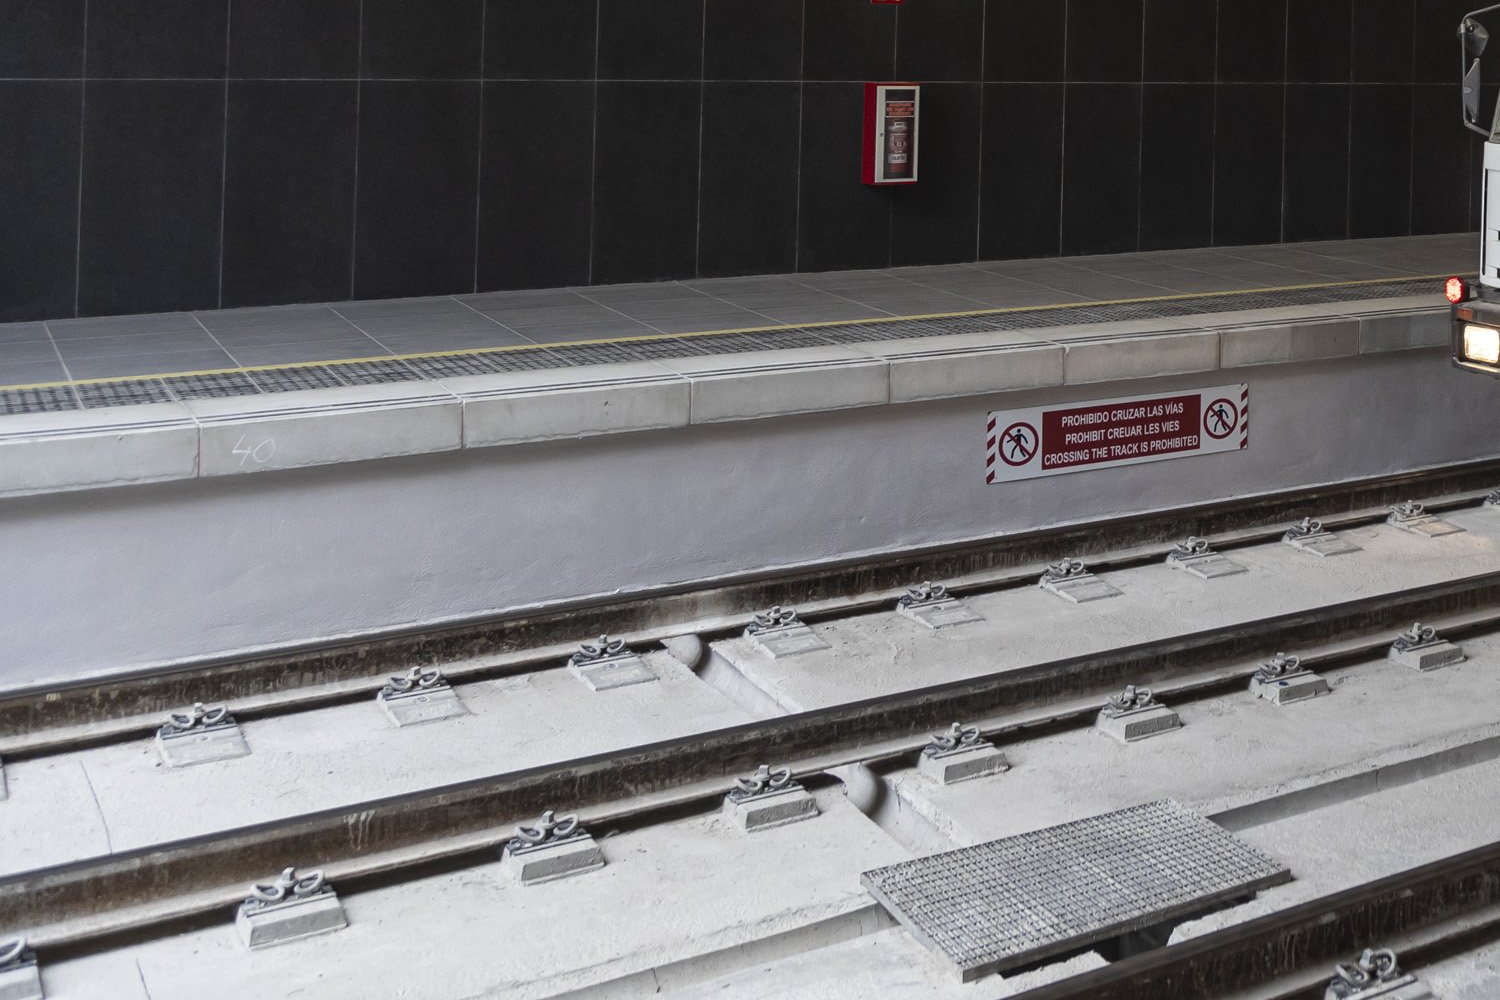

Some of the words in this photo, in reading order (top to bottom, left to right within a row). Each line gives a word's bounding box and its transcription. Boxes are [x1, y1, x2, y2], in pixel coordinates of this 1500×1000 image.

[1061, 411, 1109, 428] PROHIBIDO
[1110, 408, 1146, 423] CRUZAR
[1147, 405, 1164, 418] LAS
[1165, 401, 1184, 416] VÍAS
[1065, 429, 1106, 445] PROHIBIT
[1107, 425, 1143, 440] CREUAR
[1144, 422, 1160, 436] LES
[1161, 419, 1180, 433] VIES
[232, 434, 276, 465] 40
[1044, 449, 1090, 467] CROSSING
[1091, 446, 1109, 460] THE
[1110, 441, 1139, 458] TRACK
[1140, 439, 1149, 453] IS
[1150, 434, 1199, 452] PROHIBITED
